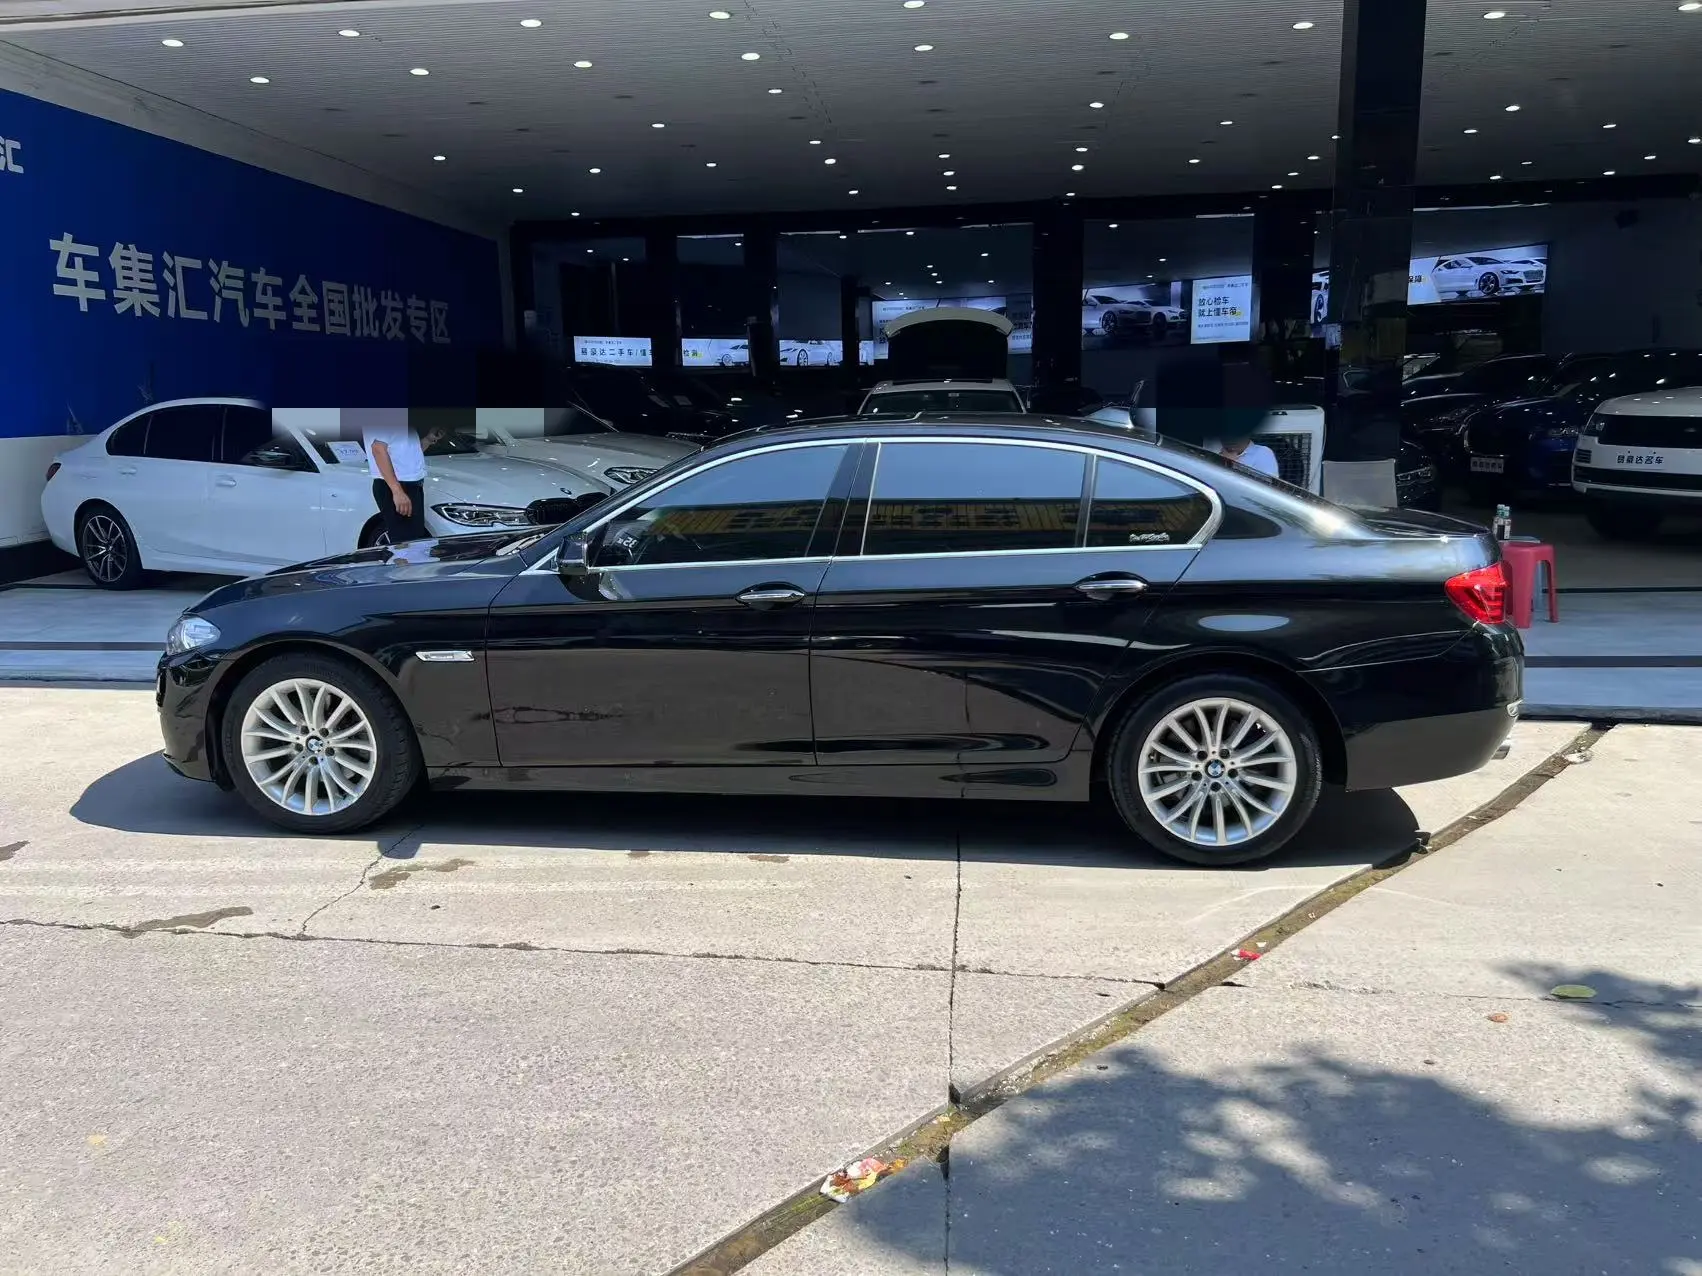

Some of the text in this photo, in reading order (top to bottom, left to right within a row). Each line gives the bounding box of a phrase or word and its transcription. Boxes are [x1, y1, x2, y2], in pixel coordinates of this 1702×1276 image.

[49, 232, 452, 345] 车集汇汽车全国批发专区
[1199, 296, 1230, 306] 放心检车
